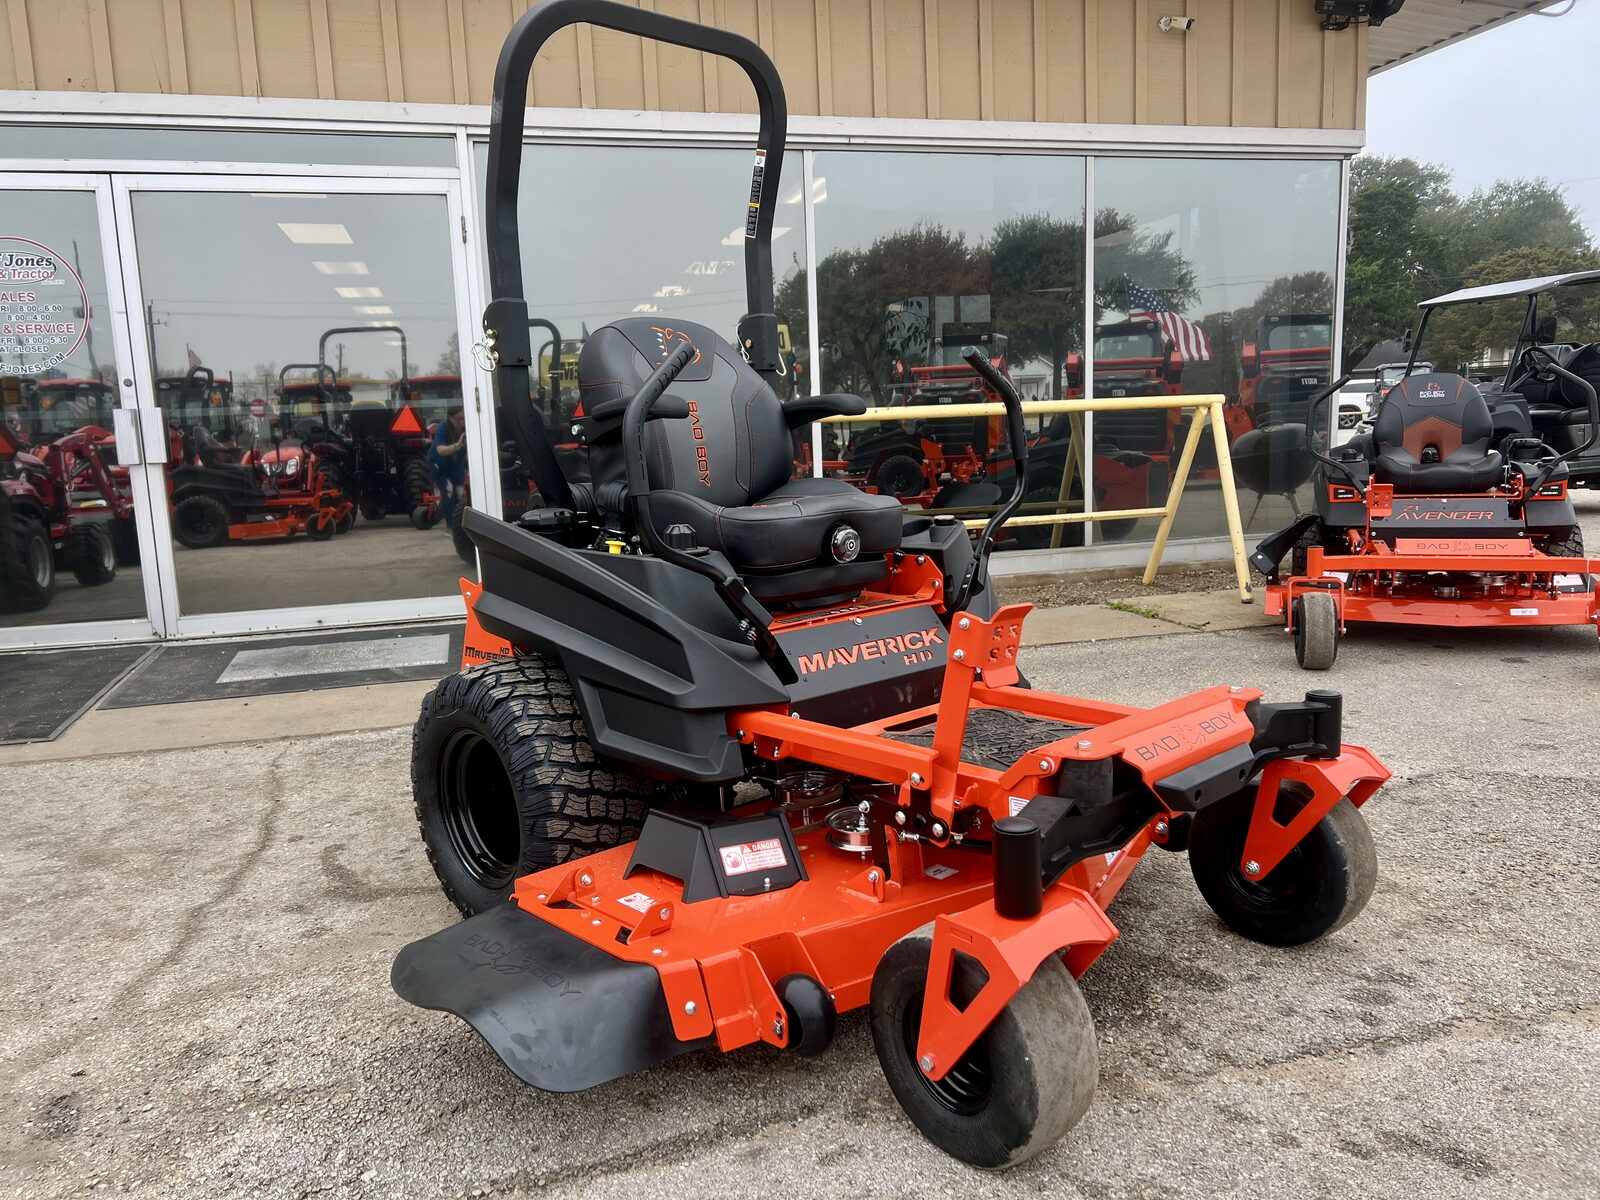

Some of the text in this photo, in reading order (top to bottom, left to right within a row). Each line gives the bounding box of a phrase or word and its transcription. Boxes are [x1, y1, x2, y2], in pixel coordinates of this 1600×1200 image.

[4, 254, 53, 267] Jones
[10, 268, 55, 279] Tractor
[0, 292, 36, 302] ALES
[3, 323, 75, 334] & SERVICE
[50, 336, 68, 344] 5:30
[12, 345, 50, 353] CLOSED
[0, 352, 66, 374] FJONES.COM
[687, 401, 711, 487] BAD BOY
[1395, 511, 1495, 520] AVENGER
[500, 647, 509, 655] HD
[797, 626, 945, 675] MAVERICK
[903, 650, 933, 666] HD
[1135, 711, 1236, 761] BAD BOY
[751, 841, 779, 852] DANGER
